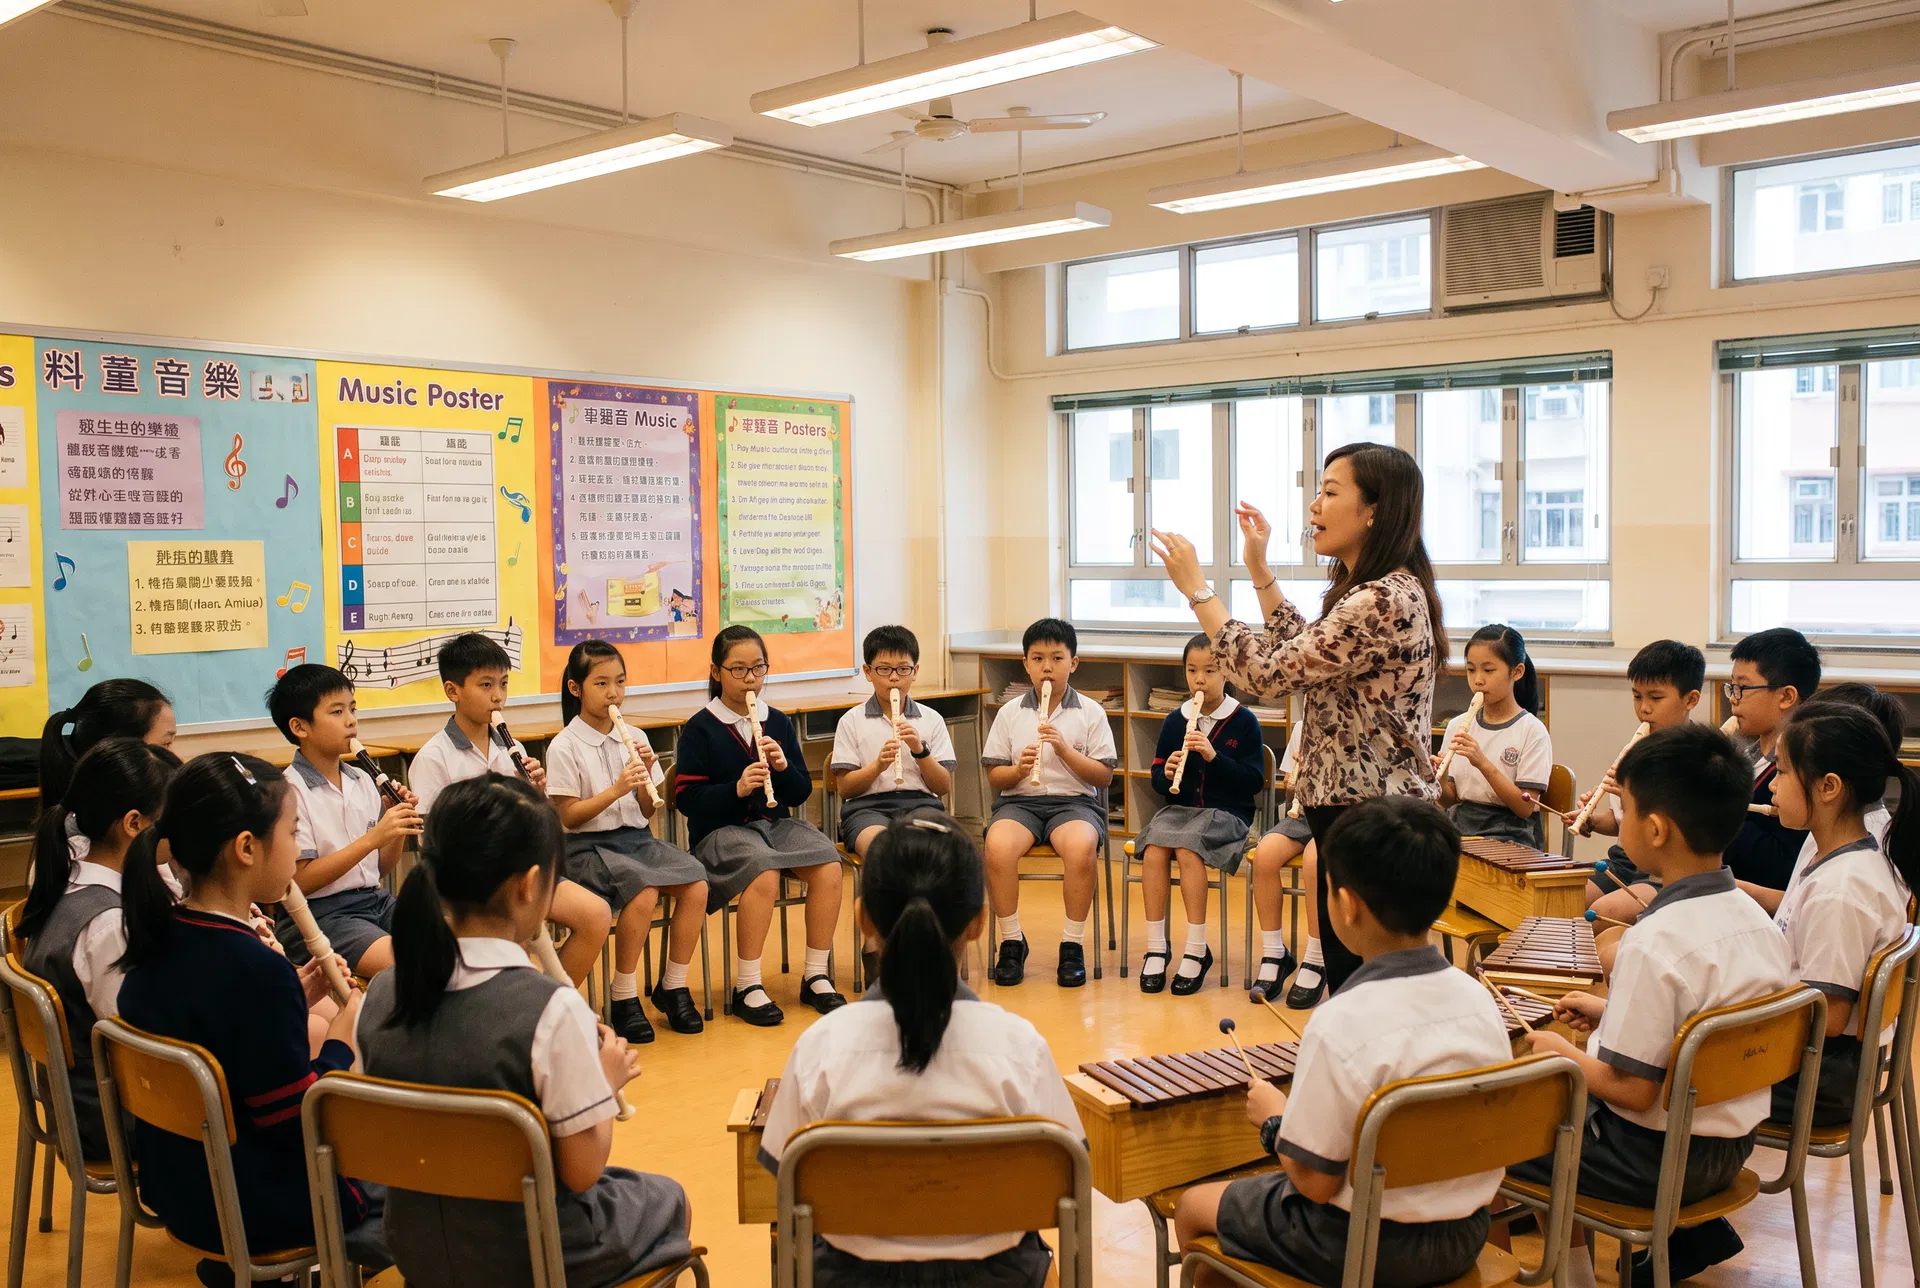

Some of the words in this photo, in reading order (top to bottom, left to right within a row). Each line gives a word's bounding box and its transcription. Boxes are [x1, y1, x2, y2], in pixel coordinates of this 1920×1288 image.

[339, 377, 418, 406] Music
[428, 383, 504, 410] Poster
[635, 411, 677, 428] Music
[343, 448, 353, 460] A
[346, 496, 355, 508] B
[347, 537, 357, 549] C
[348, 579, 358, 591] D
[350, 612, 358, 623] E
